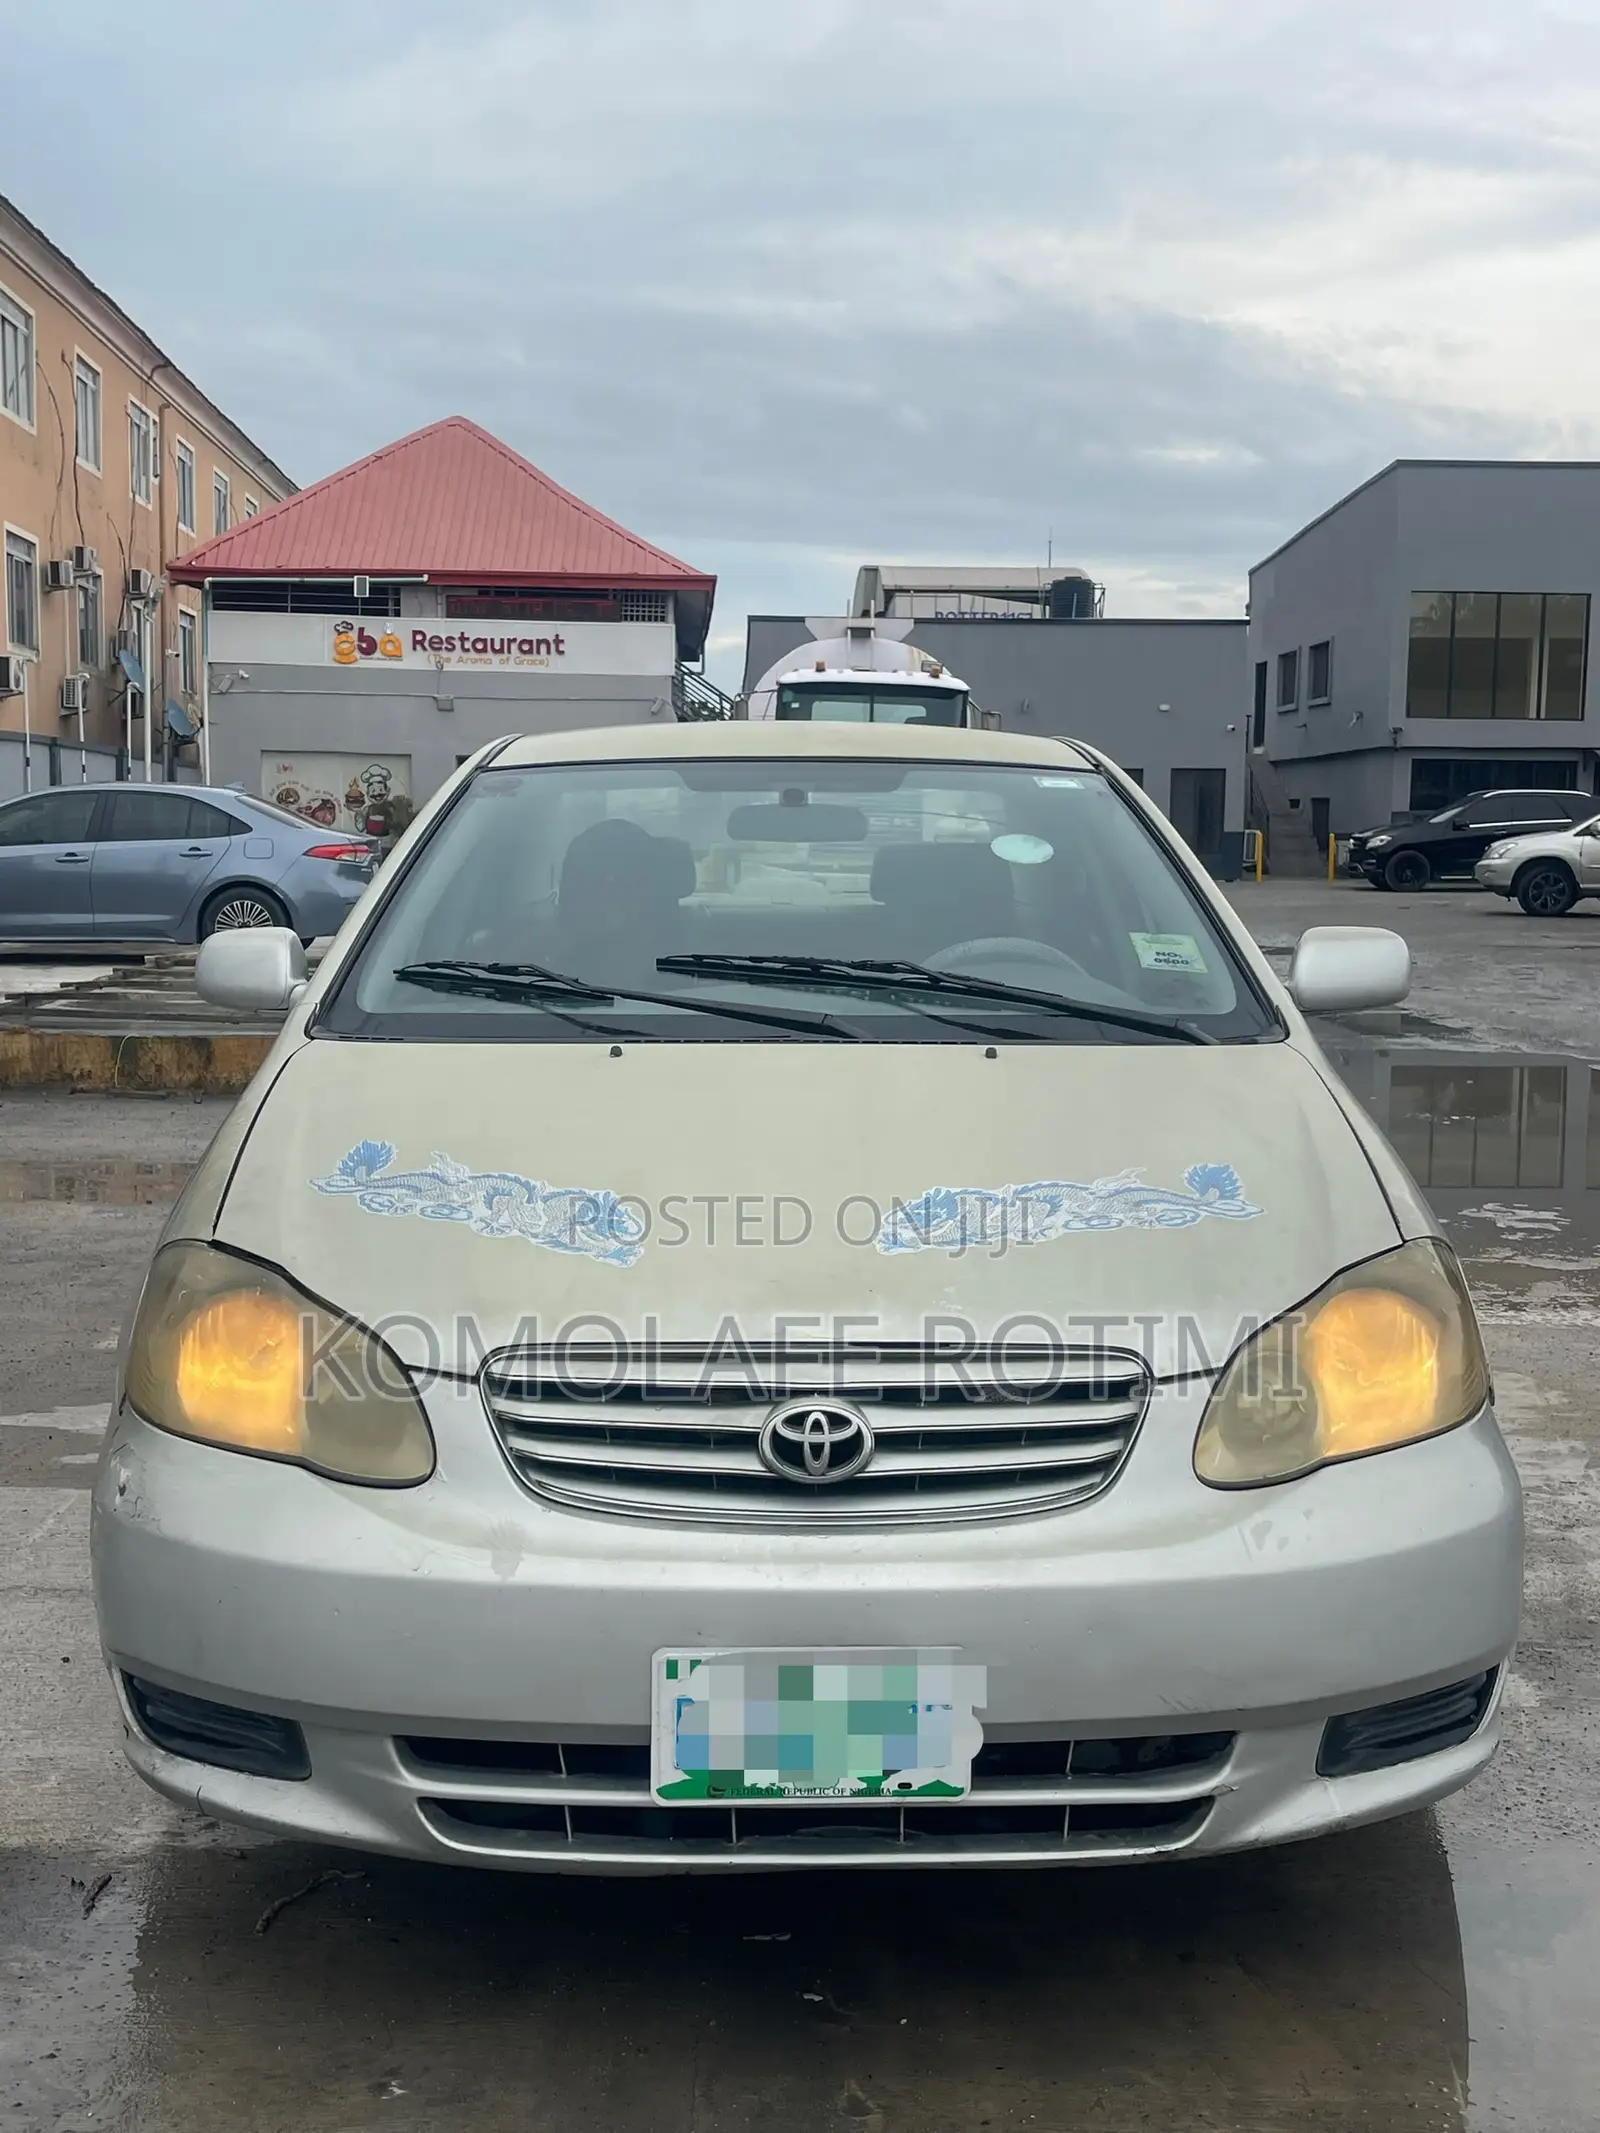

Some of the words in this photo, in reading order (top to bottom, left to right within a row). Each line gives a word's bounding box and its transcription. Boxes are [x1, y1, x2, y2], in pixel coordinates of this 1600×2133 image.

[412, 630, 565, 655] Restaurant
[457, 656, 492, 665] Aroma
[499, 656, 510, 665] of
[515, 656, 549, 667] Grace)
[833, 1786, 846, 1796] OF
